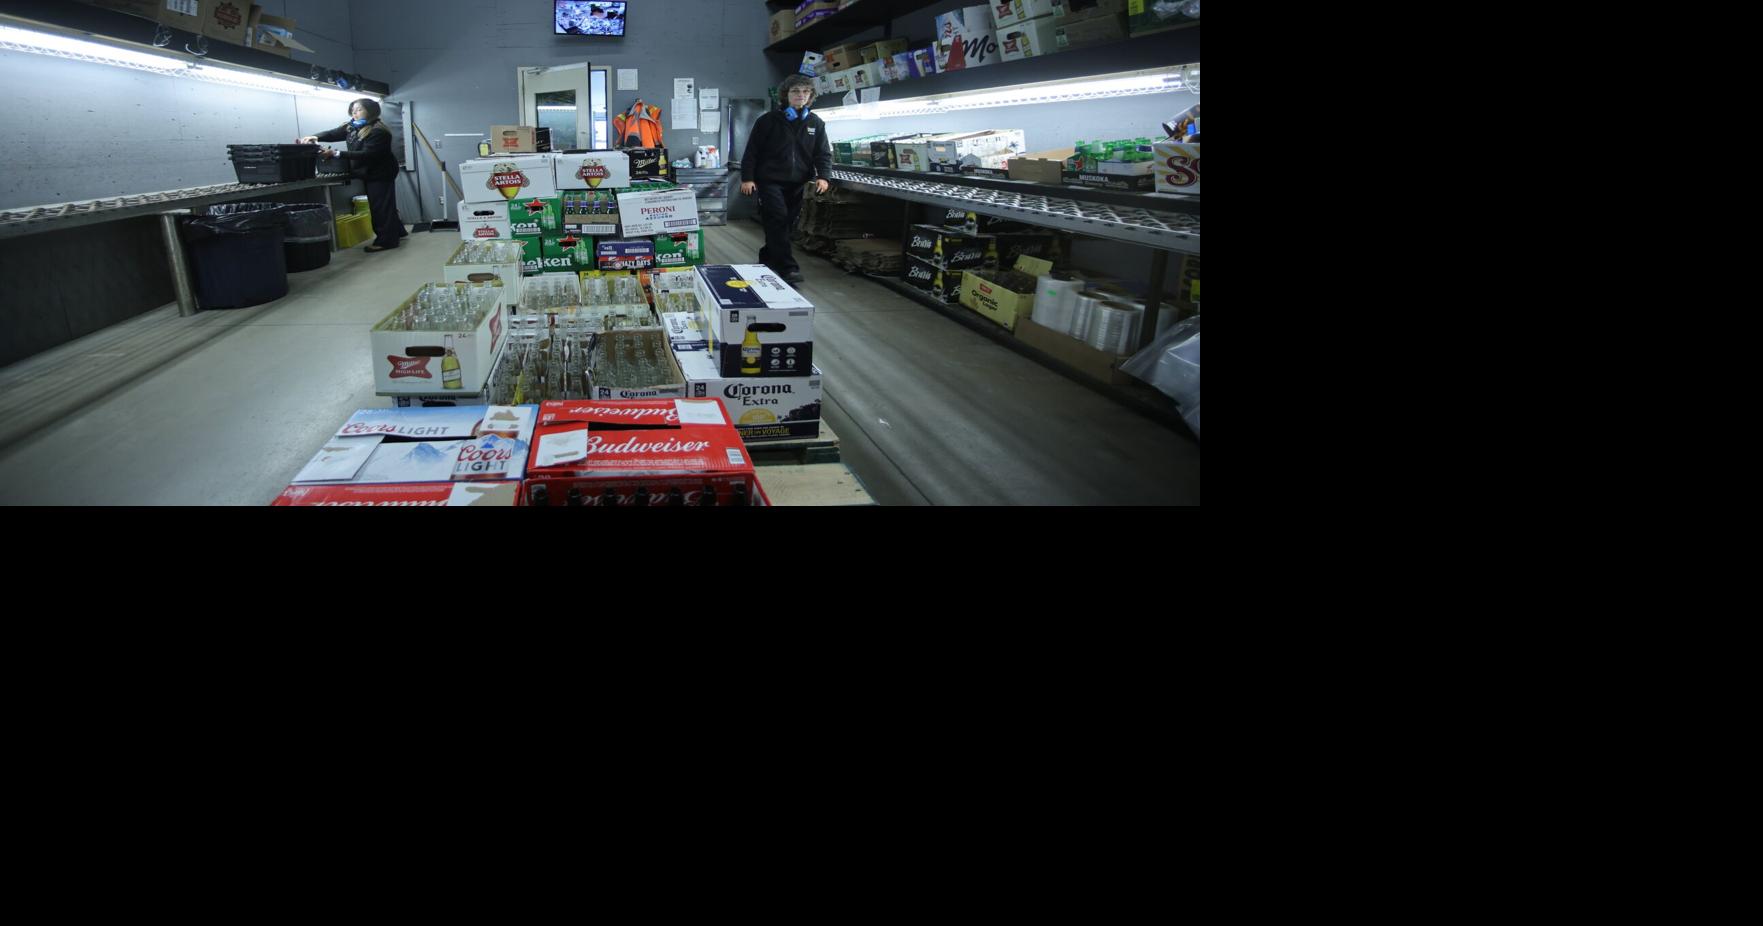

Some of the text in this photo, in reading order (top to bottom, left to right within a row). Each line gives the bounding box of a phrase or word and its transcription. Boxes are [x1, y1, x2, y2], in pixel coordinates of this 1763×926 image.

[1079, 174, 1109, 183] MUSKOKA
[640, 205, 676, 215] PERONI
[972, 289, 998, 307] Organic
[620, 390, 657, 399] Corona
[724, 383, 793, 400] Corona
[742, 397, 779, 406] Extra
[341, 421, 449, 436] Coors LIGHT
[457, 444, 512, 462] Coors
[455, 461, 506, 473] LIGHT
